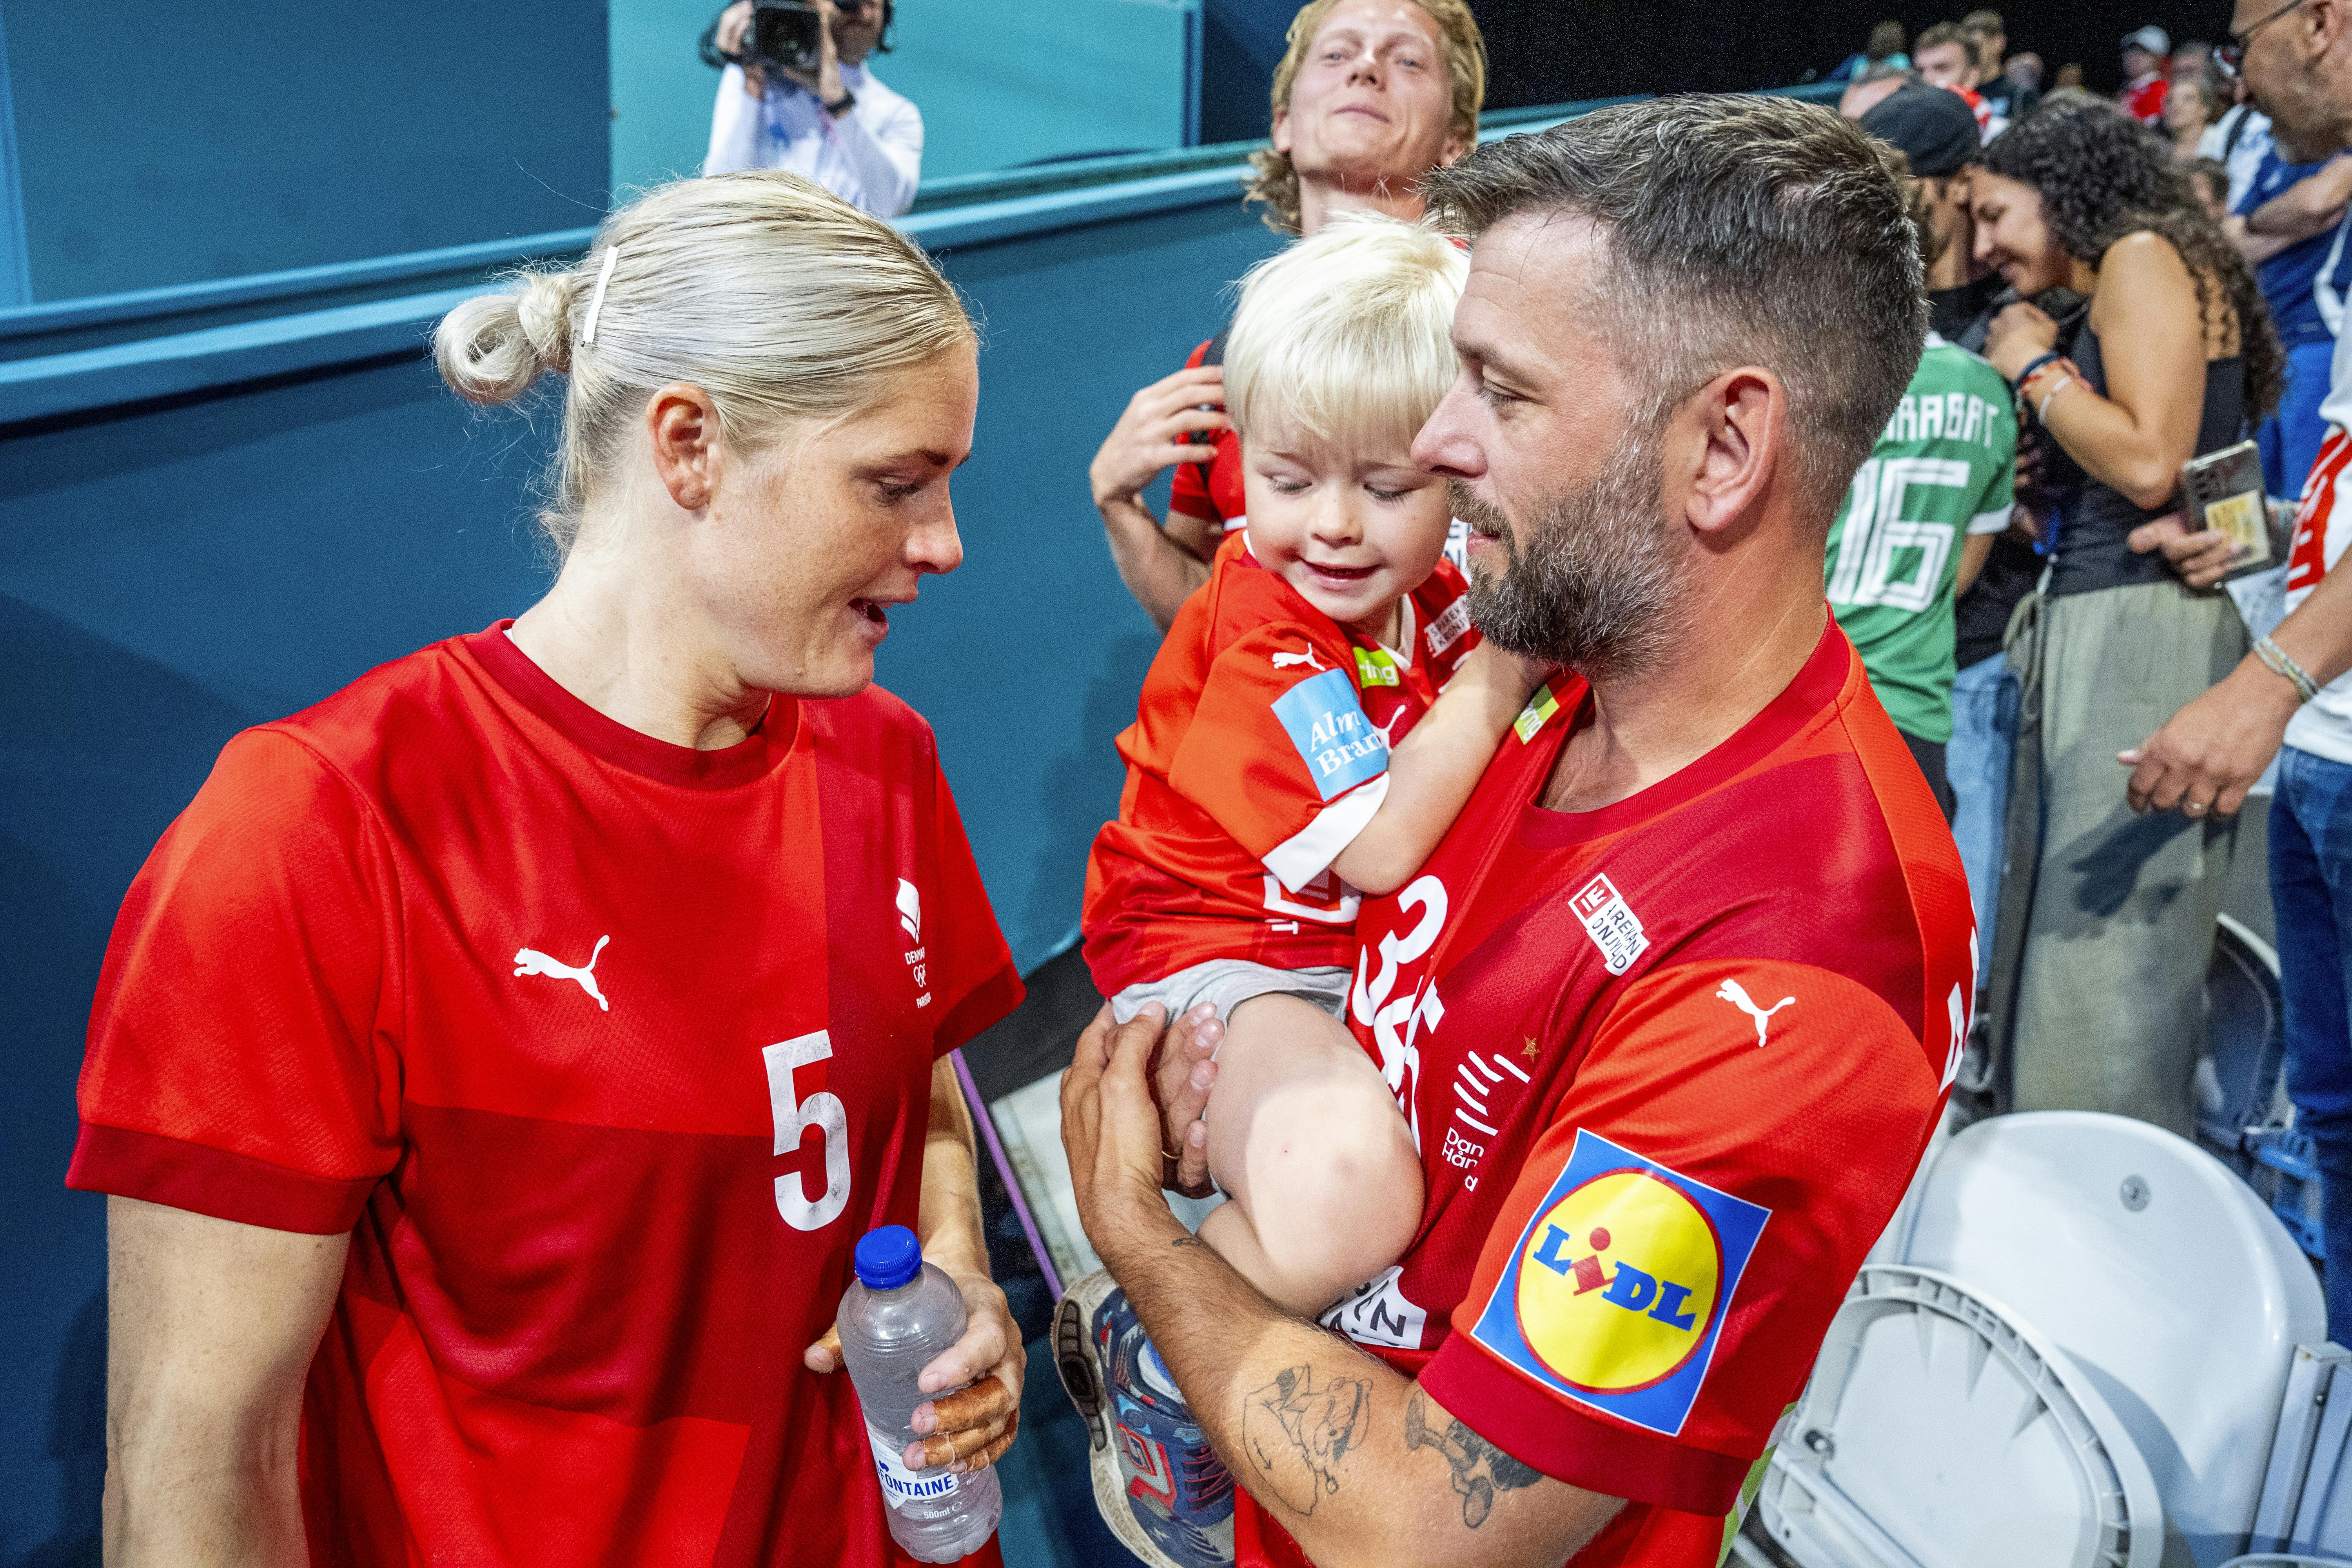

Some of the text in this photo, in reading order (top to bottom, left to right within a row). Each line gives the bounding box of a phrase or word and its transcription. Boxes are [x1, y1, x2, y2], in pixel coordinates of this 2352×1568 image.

[1824, 457, 1971, 612] 16
[762, 1029, 851, 1232] 5
[924, 1506, 950, 1519] 500ml
